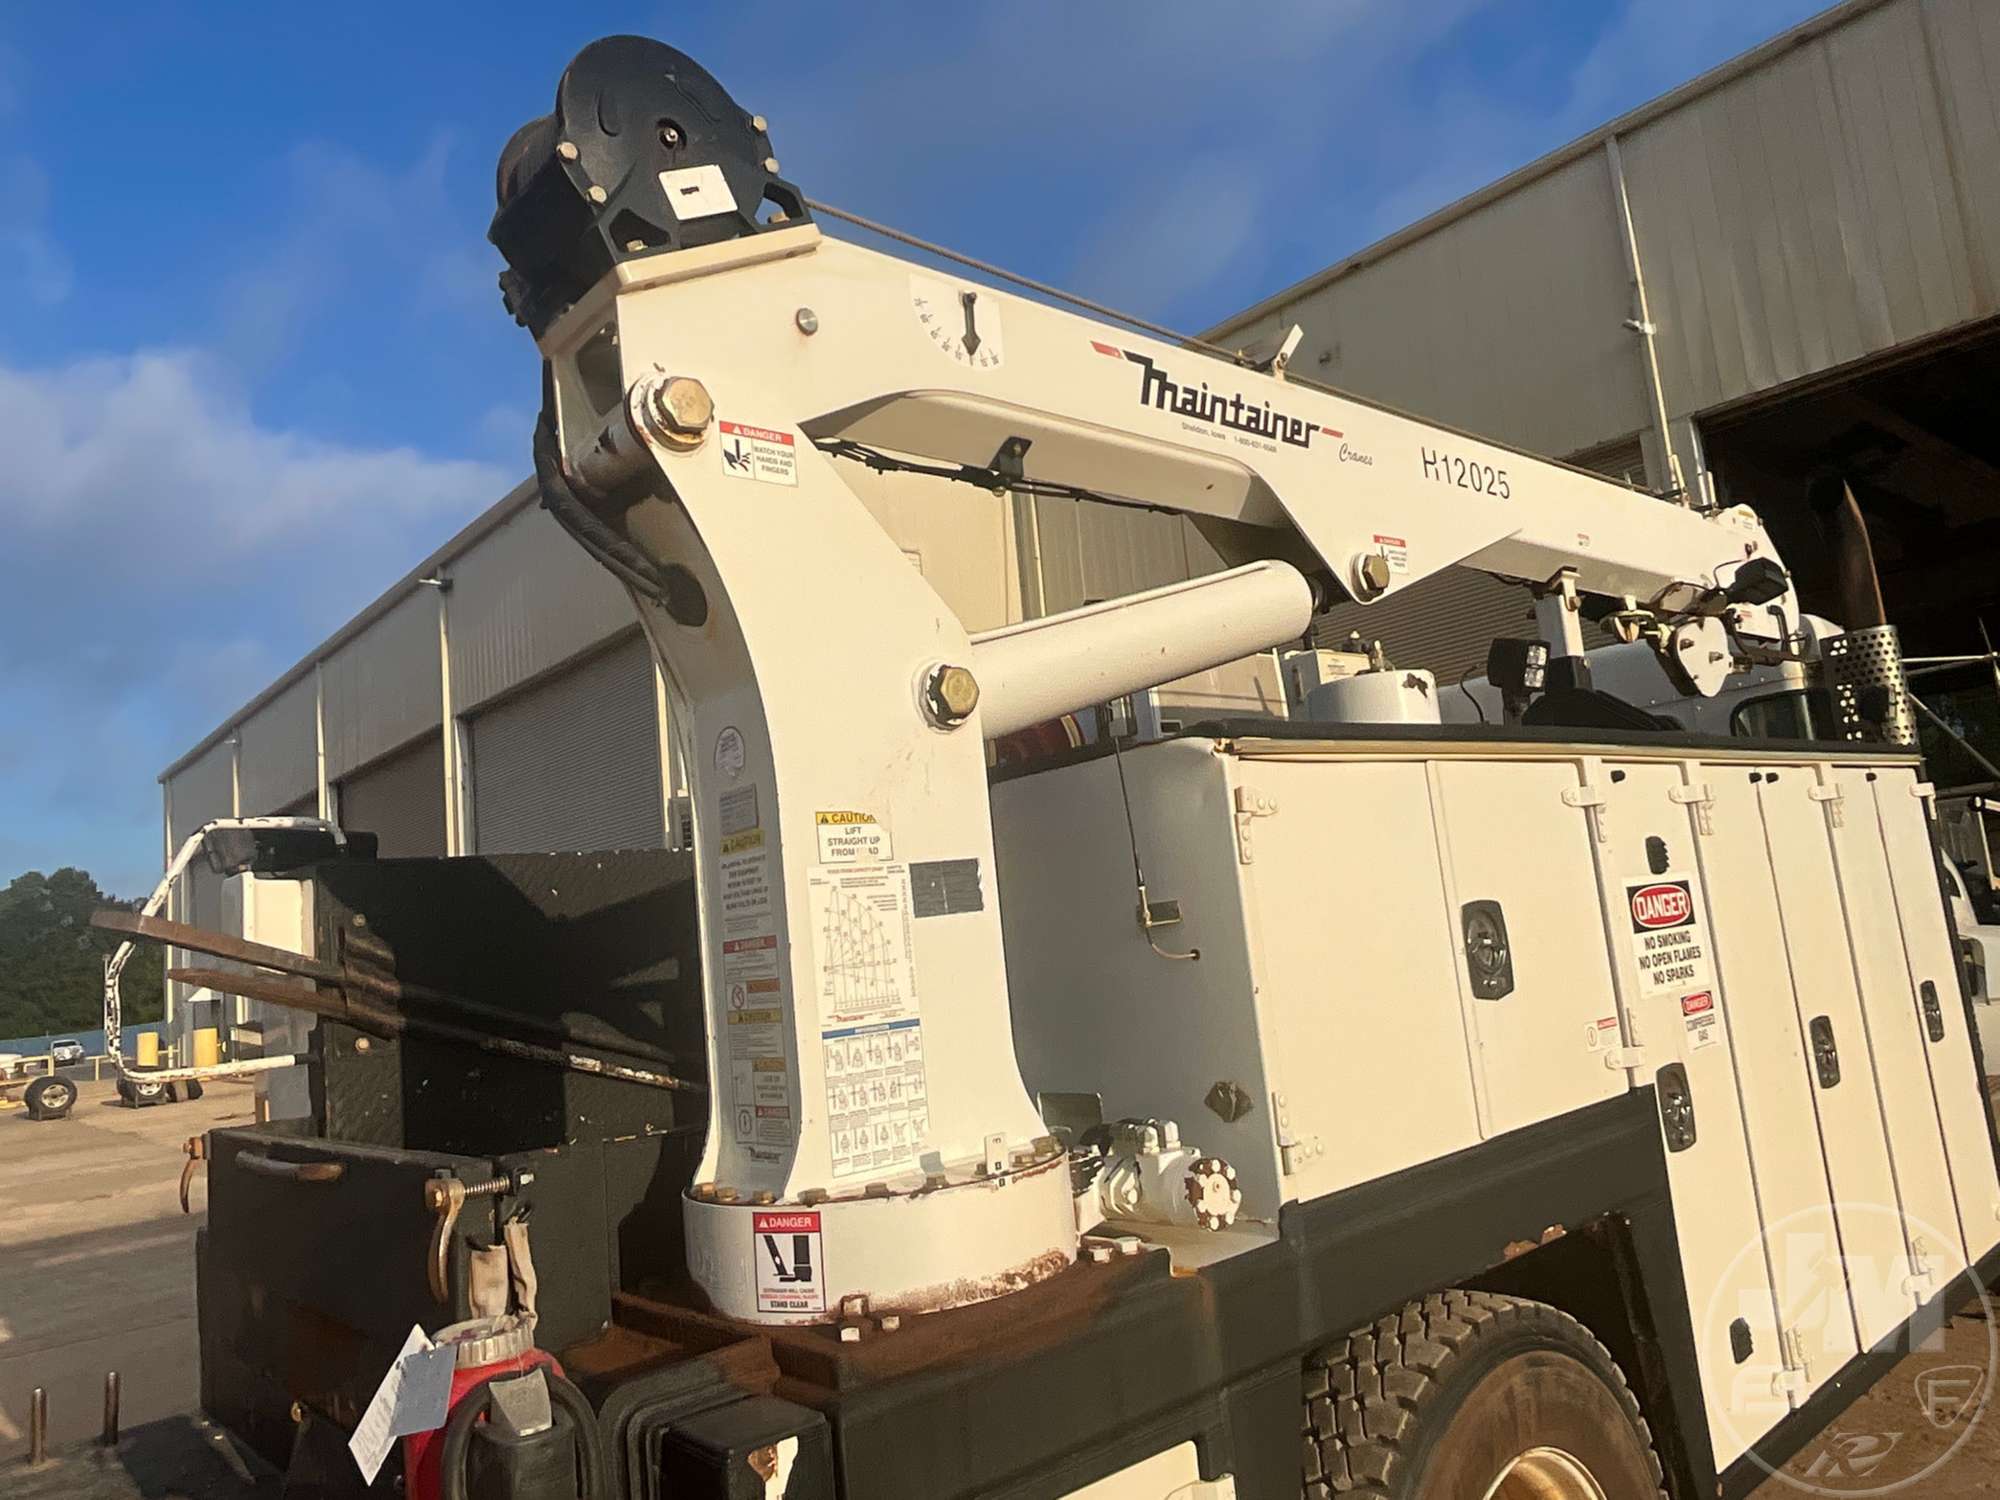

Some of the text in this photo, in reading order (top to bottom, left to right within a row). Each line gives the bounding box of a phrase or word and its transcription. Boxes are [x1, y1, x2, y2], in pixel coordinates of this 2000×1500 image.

[1123, 350, 1320, 448] Maintainer
[743, 428, 783, 442] DANGER
[1338, 442, 1374, 467] Cranes
[761, 464, 789, 476] FINGERS
[1420, 446, 1511, 500] H12025
[844, 826, 861, 835] LIFT
[827, 836, 881, 847] STRAIGHT UP
[831, 848, 856, 857] FROM
[1636, 892, 1687, 920] DANGER
[1644, 931, 1692, 951] NO SMOKING
[1638, 946, 1702, 970] NO OPEN FLAMES
[1653, 964, 1695, 985] NO SPARKS
[769, 1217, 812, 1227] DANGER
[770, 1301, 808, 1309] STAND CLEAR
